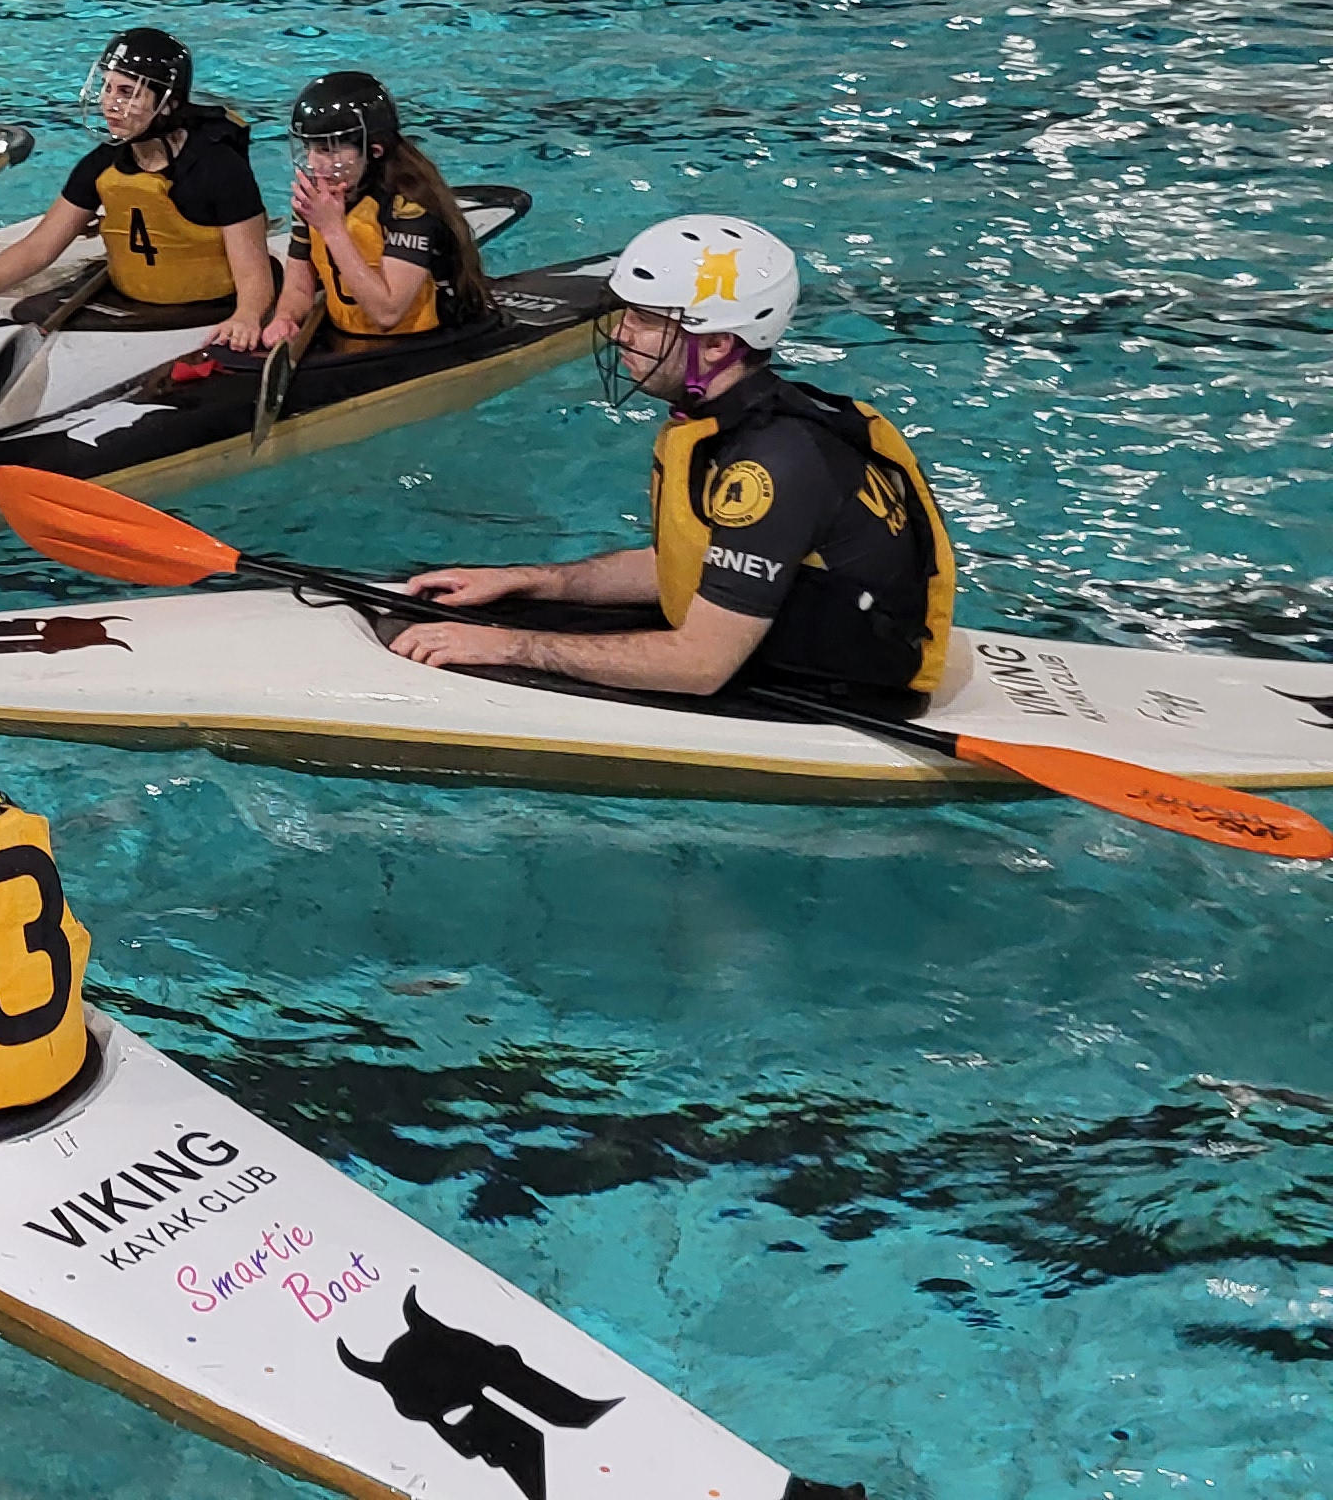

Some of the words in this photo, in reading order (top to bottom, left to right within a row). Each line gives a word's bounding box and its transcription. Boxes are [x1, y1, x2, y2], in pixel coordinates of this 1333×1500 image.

[129, 207, 159, 267] 4
[976, 643, 1070, 717] VIKING
[1037, 652, 1080, 687] CLUB
[21, 1131, 240, 1248] VIKING
[99, 1207, 208, 1272] KAYAK
[197, 1165, 278, 1214] CLUB
[176, 1221, 315, 1313] Smartie
[281, 1250, 382, 1324] Boat
